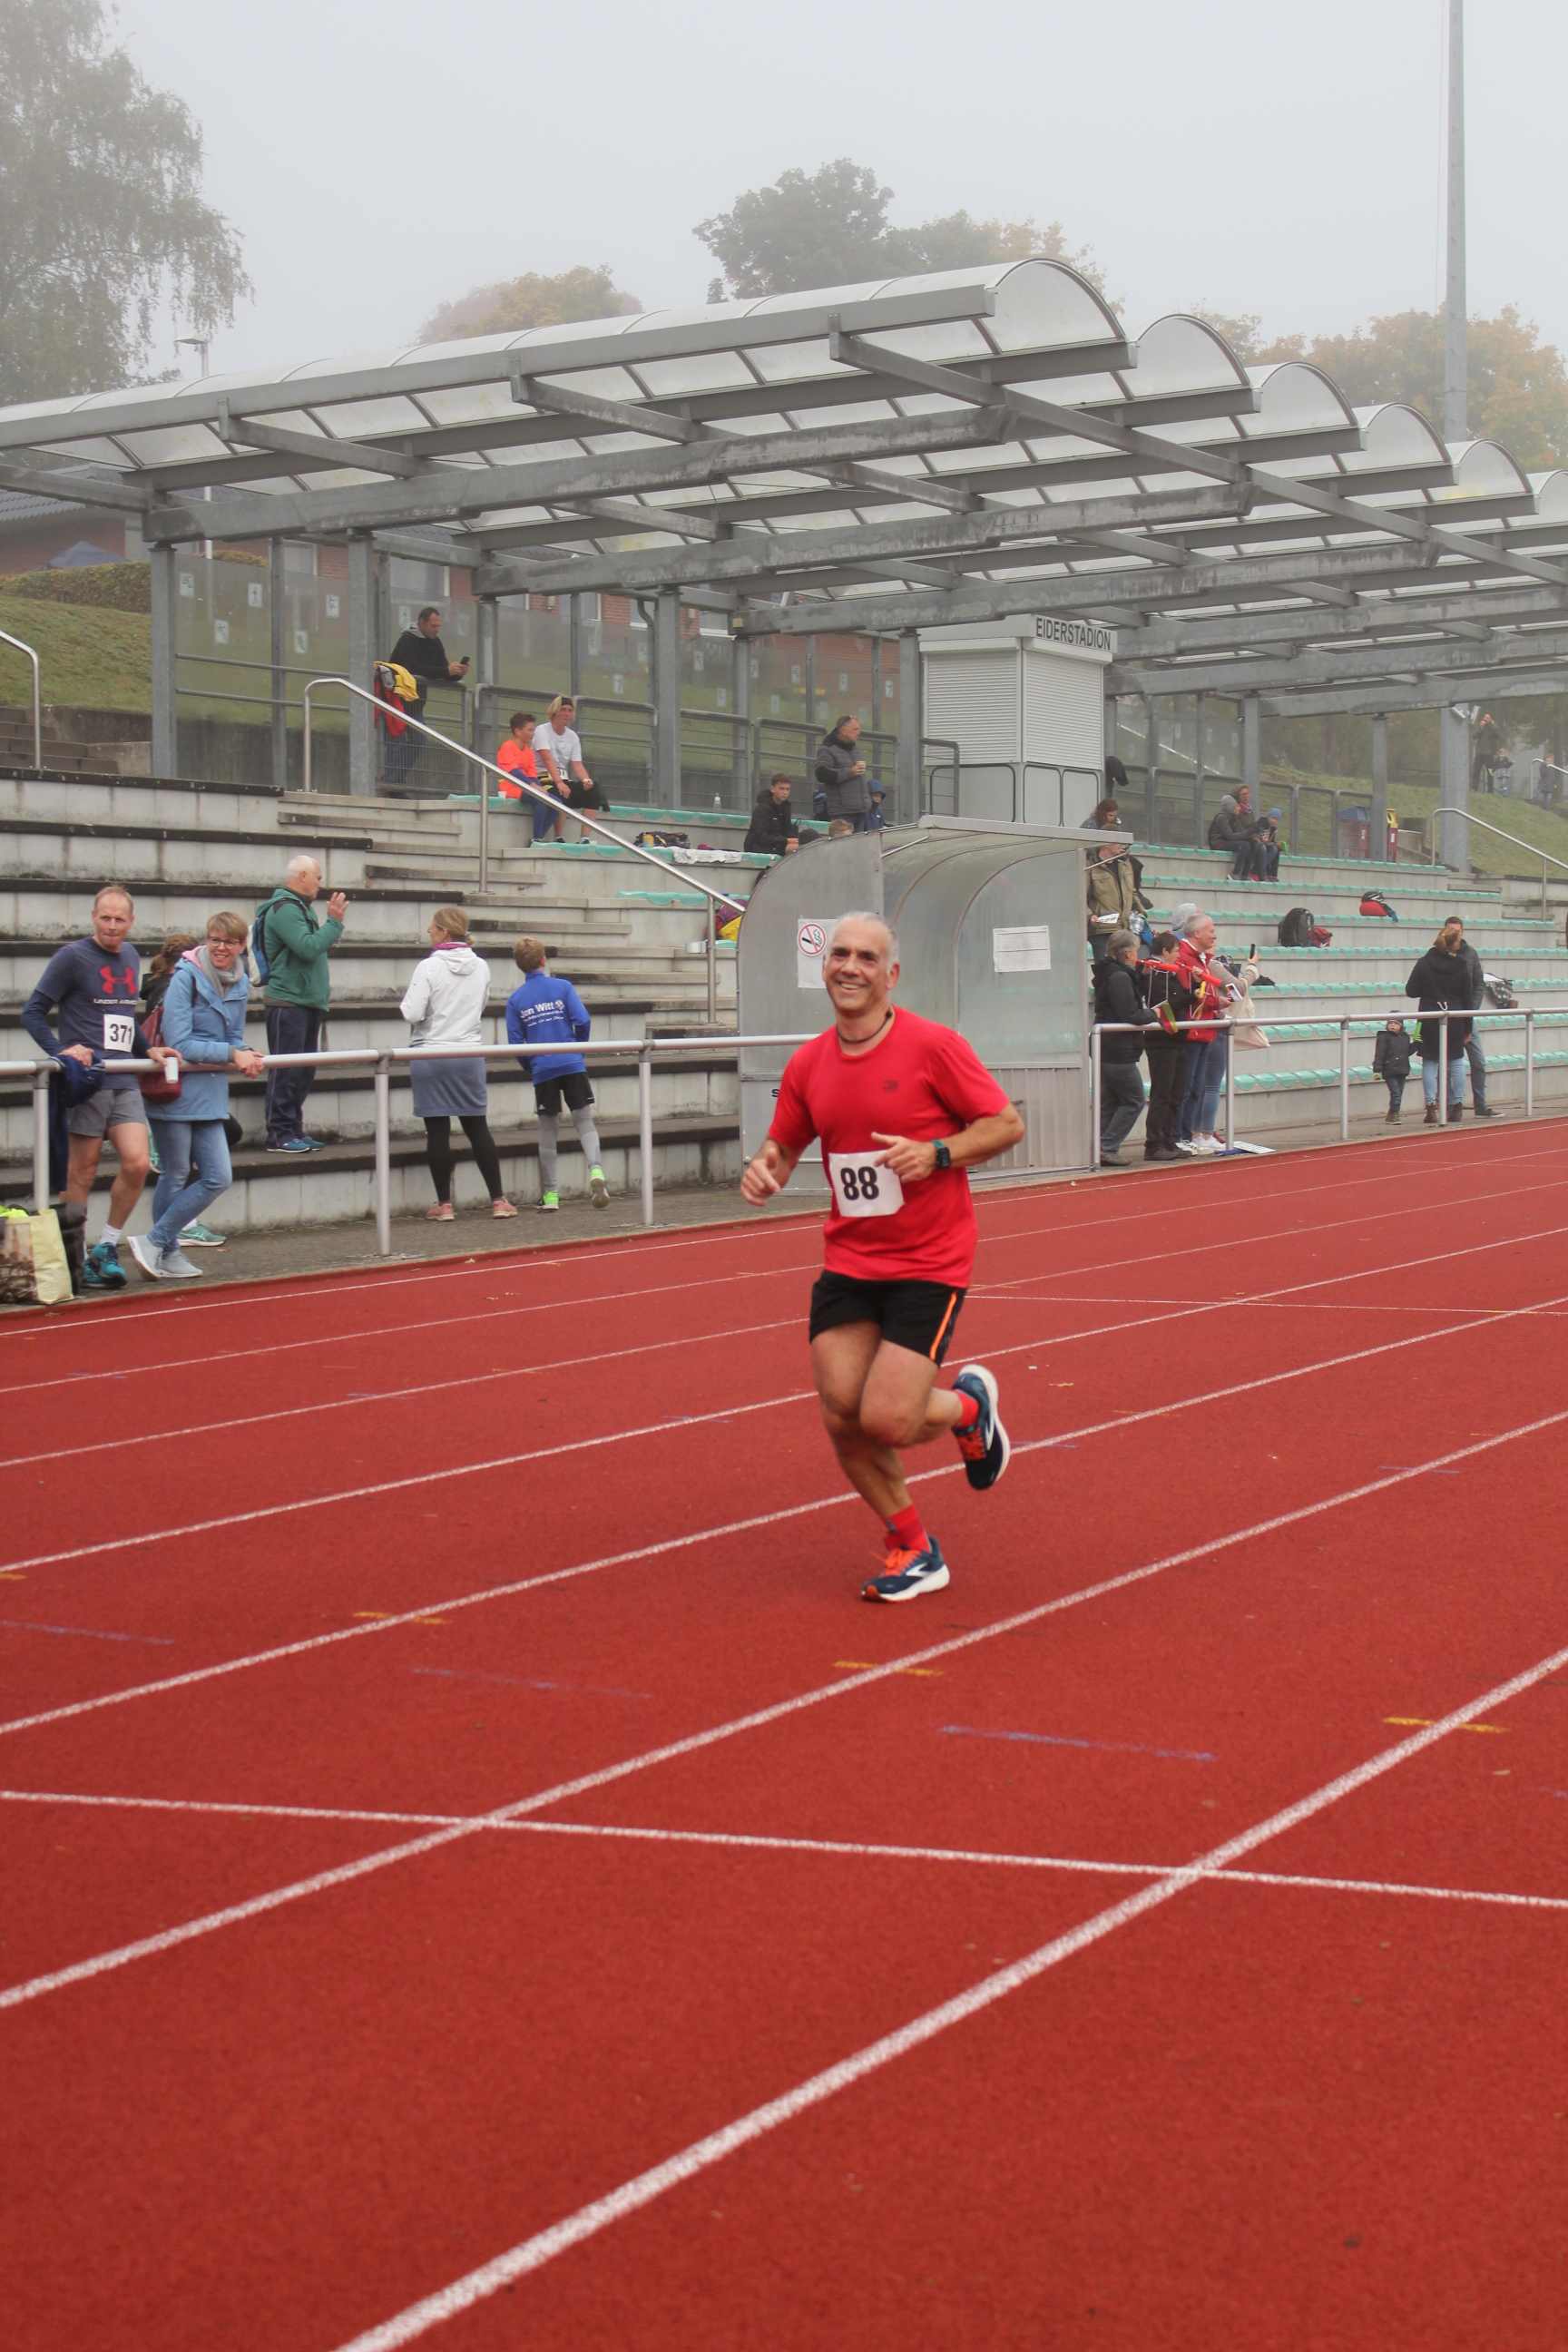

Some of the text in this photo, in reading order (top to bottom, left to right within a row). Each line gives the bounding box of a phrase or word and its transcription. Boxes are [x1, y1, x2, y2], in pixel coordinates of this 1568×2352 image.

[1036, 617, 1111, 651] EIDERSTADION
[109, 1023, 132, 1044] 371
[840, 1166, 879, 1200] 88
